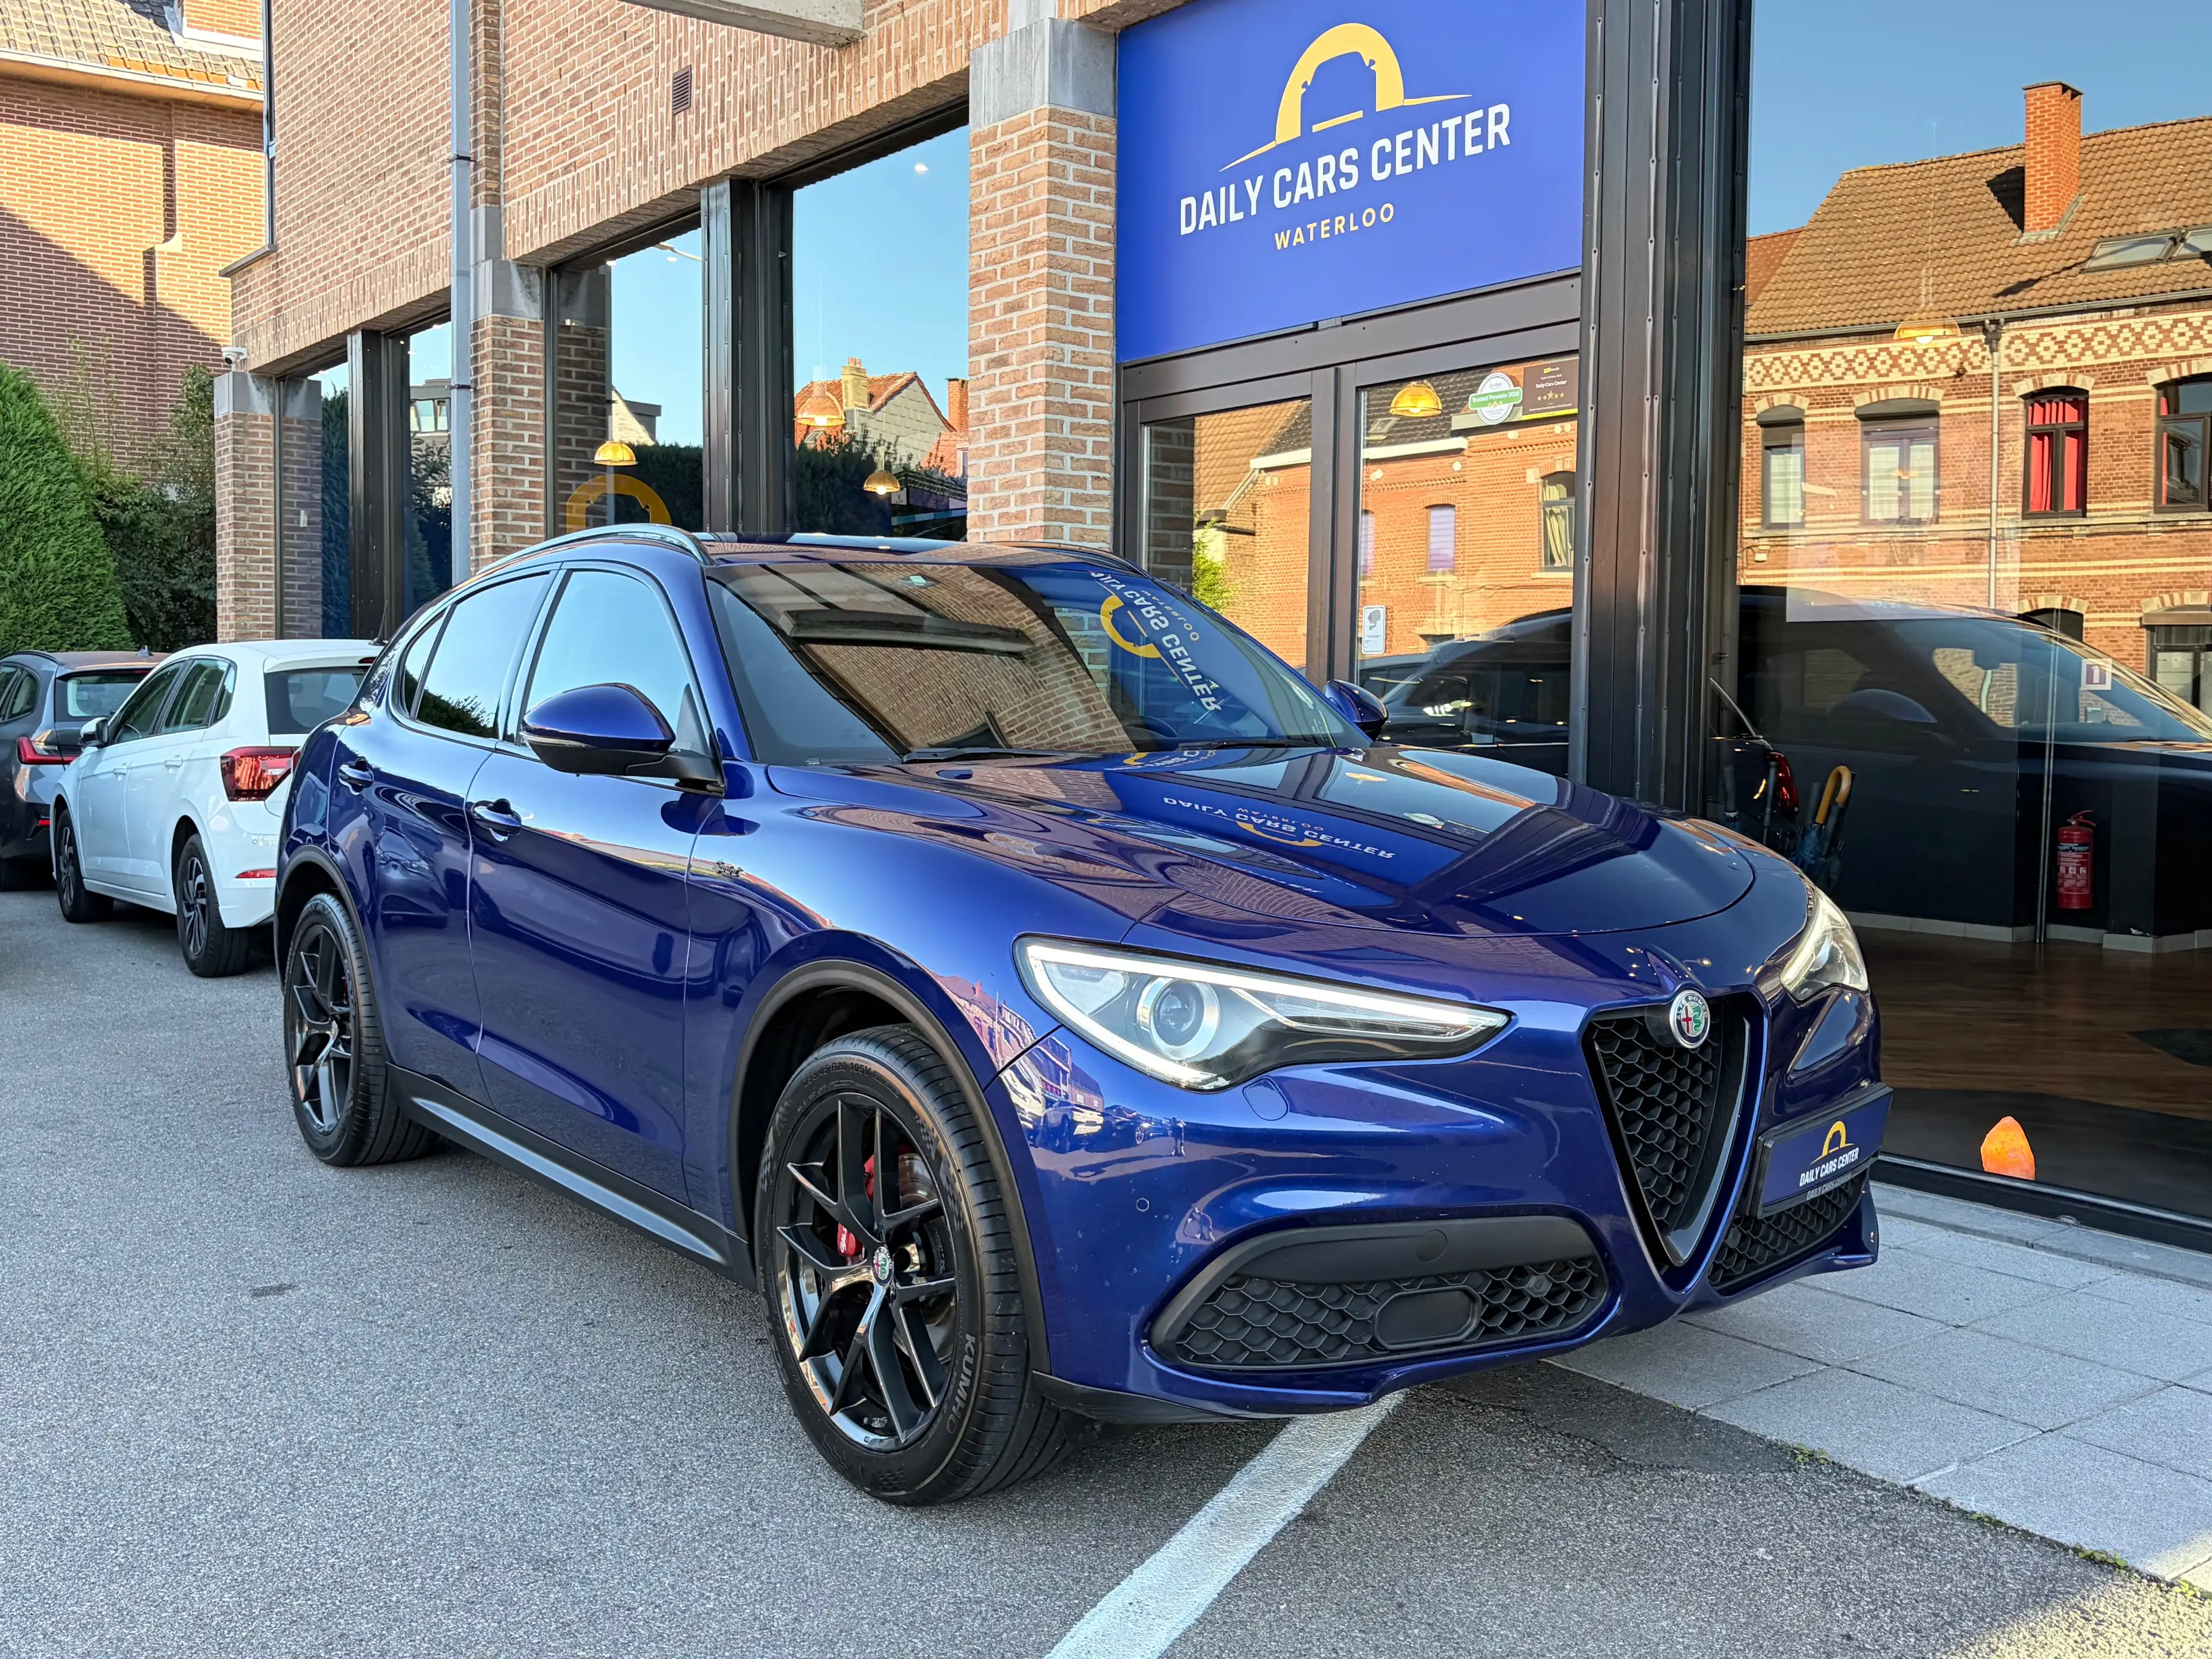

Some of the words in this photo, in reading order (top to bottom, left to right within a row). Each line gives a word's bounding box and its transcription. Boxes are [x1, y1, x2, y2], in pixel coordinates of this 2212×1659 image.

[1180, 175, 1264, 236] DAILY
[1272, 147, 1359, 209] CARS
[1370, 103, 1511, 179] CENTER
[1274, 203, 1395, 250] WATERLOO
[1676, 998, 1687, 1021] ALFA
[1688, 995, 1708, 1018] ROMEO
[1800, 1166, 1820, 1187] DAILY
[1820, 1158, 1838, 1177] CARS
[1838, 1147, 1859, 1169] CENTER
[946, 1334, 976, 1434] KUMHO
